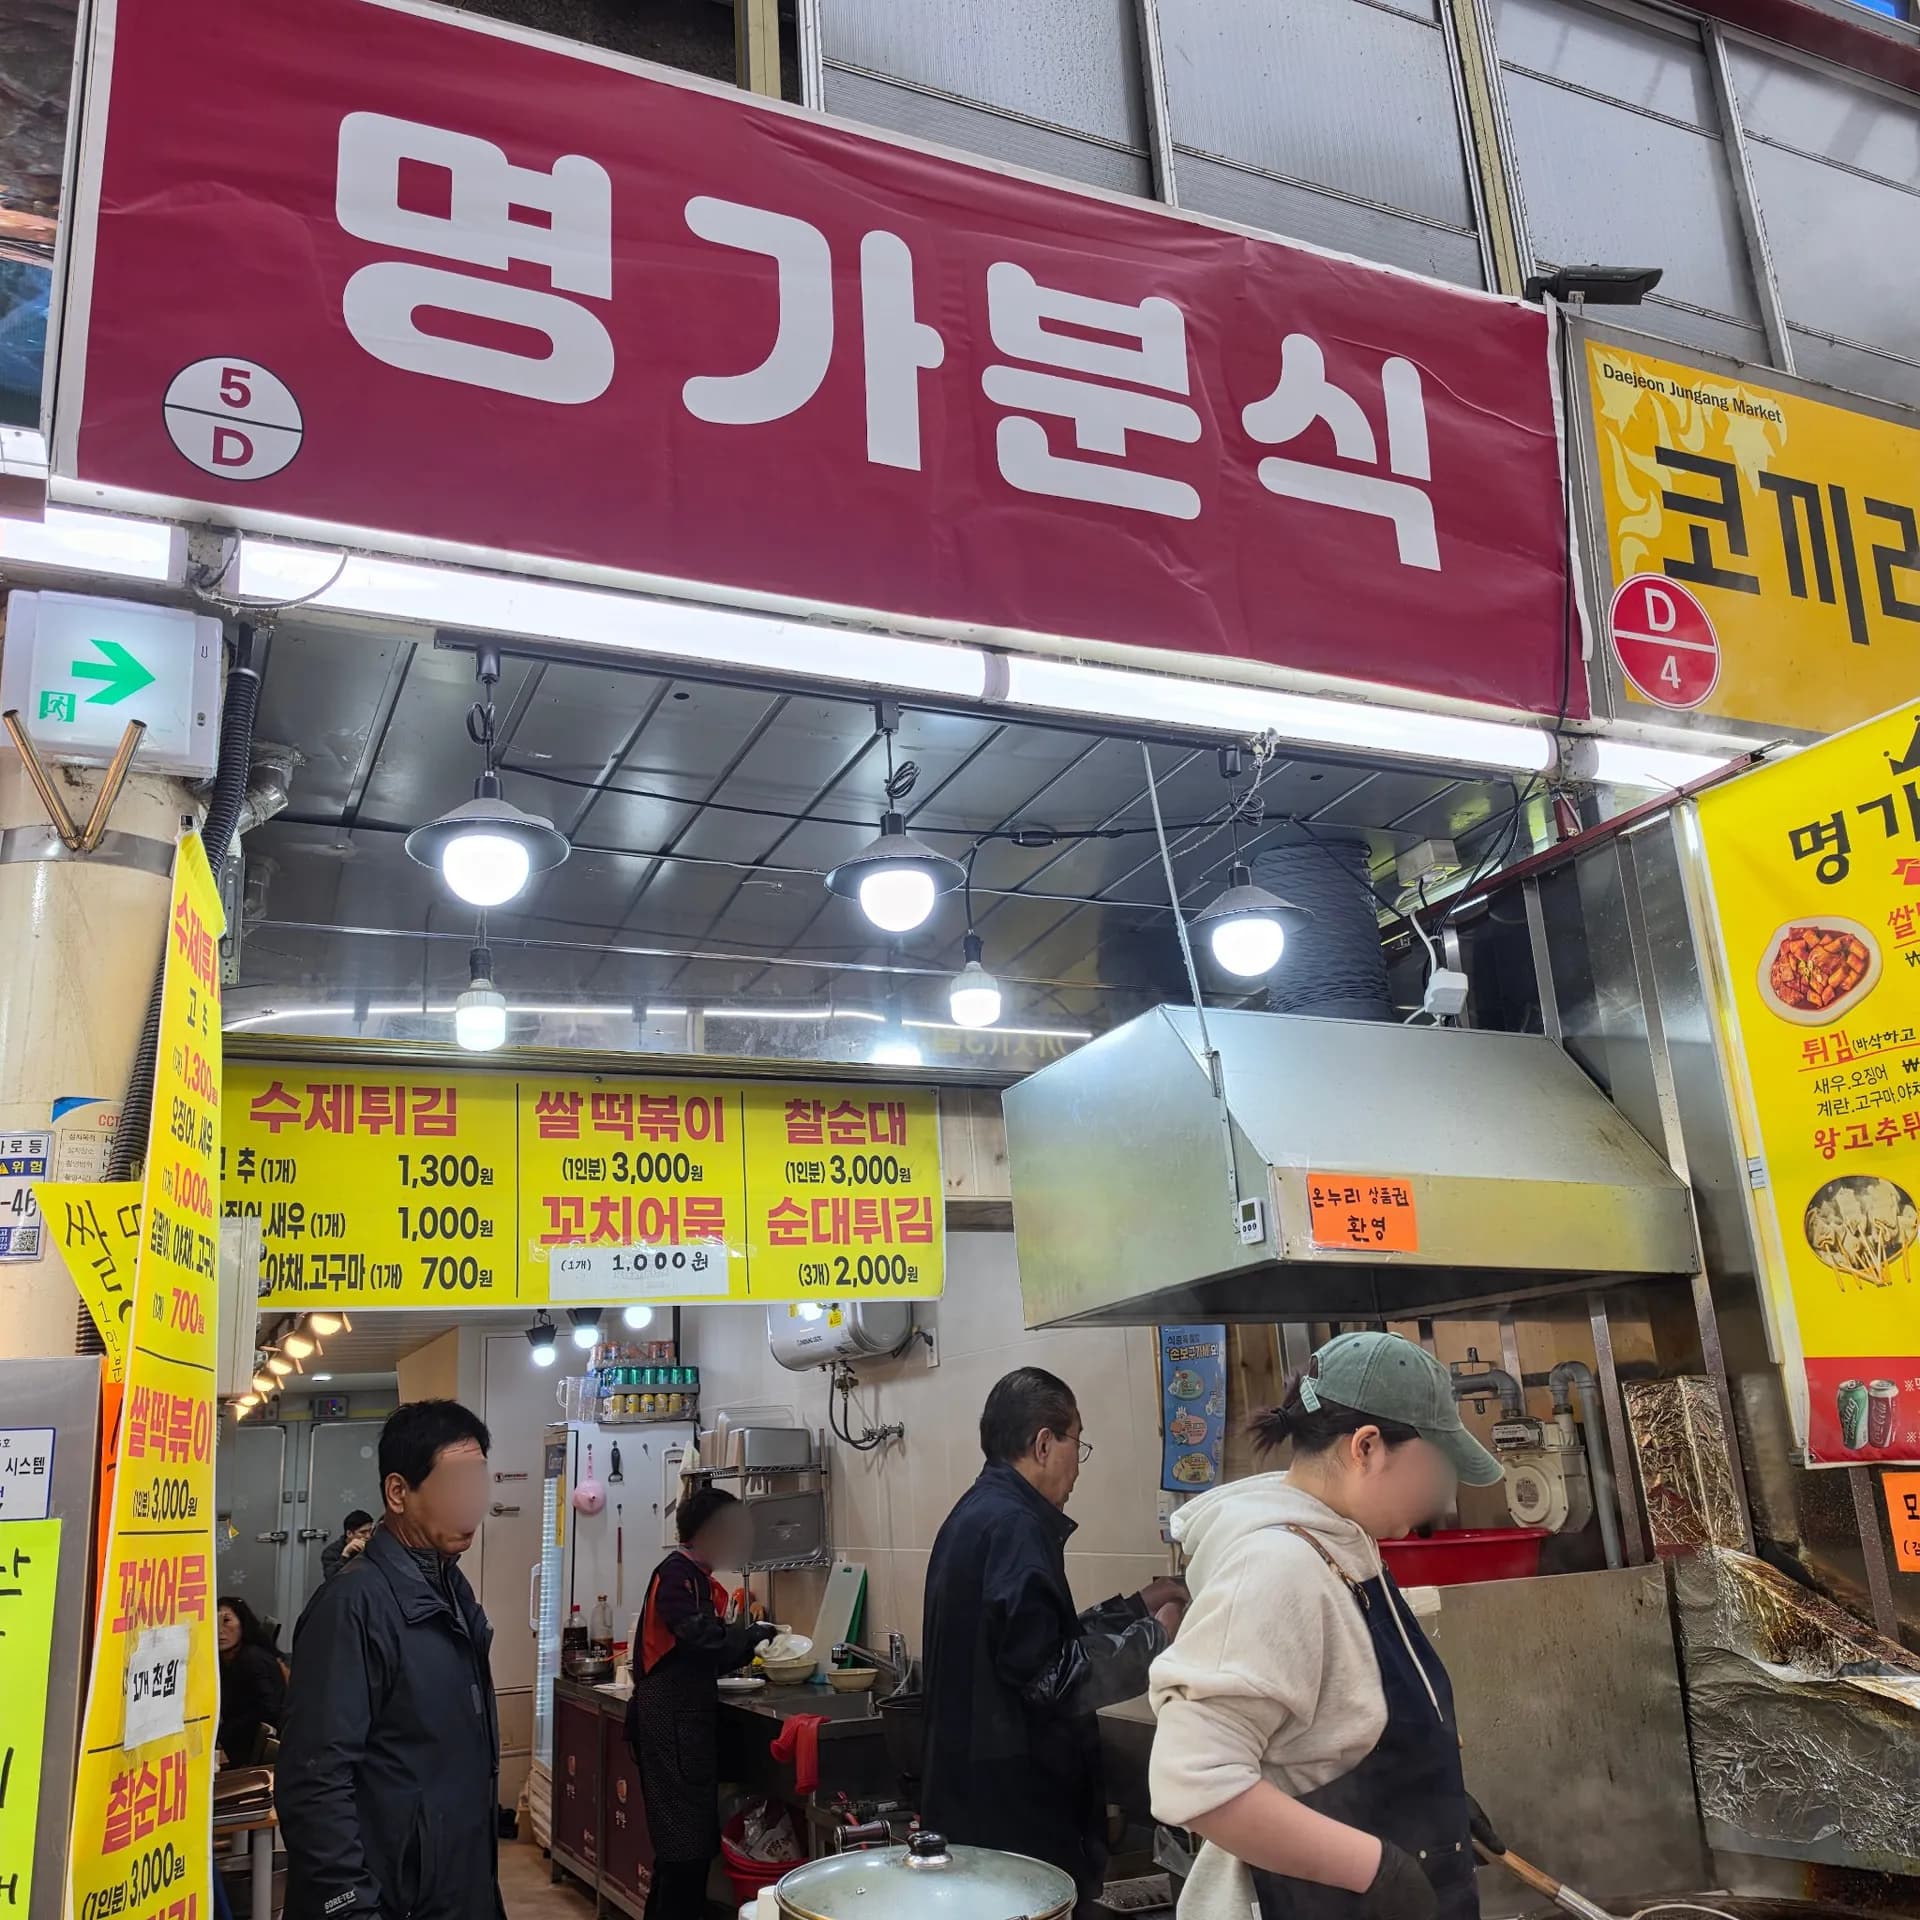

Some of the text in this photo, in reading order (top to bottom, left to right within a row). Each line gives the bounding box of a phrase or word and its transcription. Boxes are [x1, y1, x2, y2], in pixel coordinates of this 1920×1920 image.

[336, 111, 1441, 571] 명가분식
[219, 367, 252, 408] 5
[1603, 363, 1783, 424] Daejeon Jungang Market
[212, 427, 254, 468] D
[1645, 588, 1677, 633] D
[1660, 655, 1682, 689] 4
[1801, 1030, 1854, 1064] 튀김
[250, 1081, 457, 1137] 수제튀김
[535, 1091, 725, 1142] 쌀떡볶이
[785, 1098, 906, 1146] 찰순대
[12, 1161, 42, 1174] 위험
[261, 1158, 297, 1184] (1개)
[398, 1155, 493, 1188] 1,300원
[562, 1152, 703, 1184] (1인분) 3,000원
[785, 1155, 911, 1186] (1인분) 3,000원
[1312, 1187, 1410, 1208] 온누리 상품권
[310, 1213, 346, 1238] (1개)
[398, 1206, 493, 1242] 1,000원
[540, 1196, 726, 1246] 꼬치어묵
[767, 1196, 933, 1246] 순대튀김
[1347, 1215, 1386, 1243] 환영
[370, 1263, 403, 1290] (1개)
[420, 1256, 493, 1290] 700원
[561, 1259, 592, 1272] (1개)
[798, 1255, 918, 1288] (3개) 2,000원
[170, 1287, 205, 1334] 700원
[129, 1385, 213, 1464] 쌀떡볶이
[5, 1456, 45, 1476] 시스템
[133, 1477, 198, 1522] (1인분) 3,000원
[112, 1555, 207, 1633] 꼬치어묵
[102, 1751, 187, 1856] 찰순대
[130, 1842, 185, 1907] 3,000원
